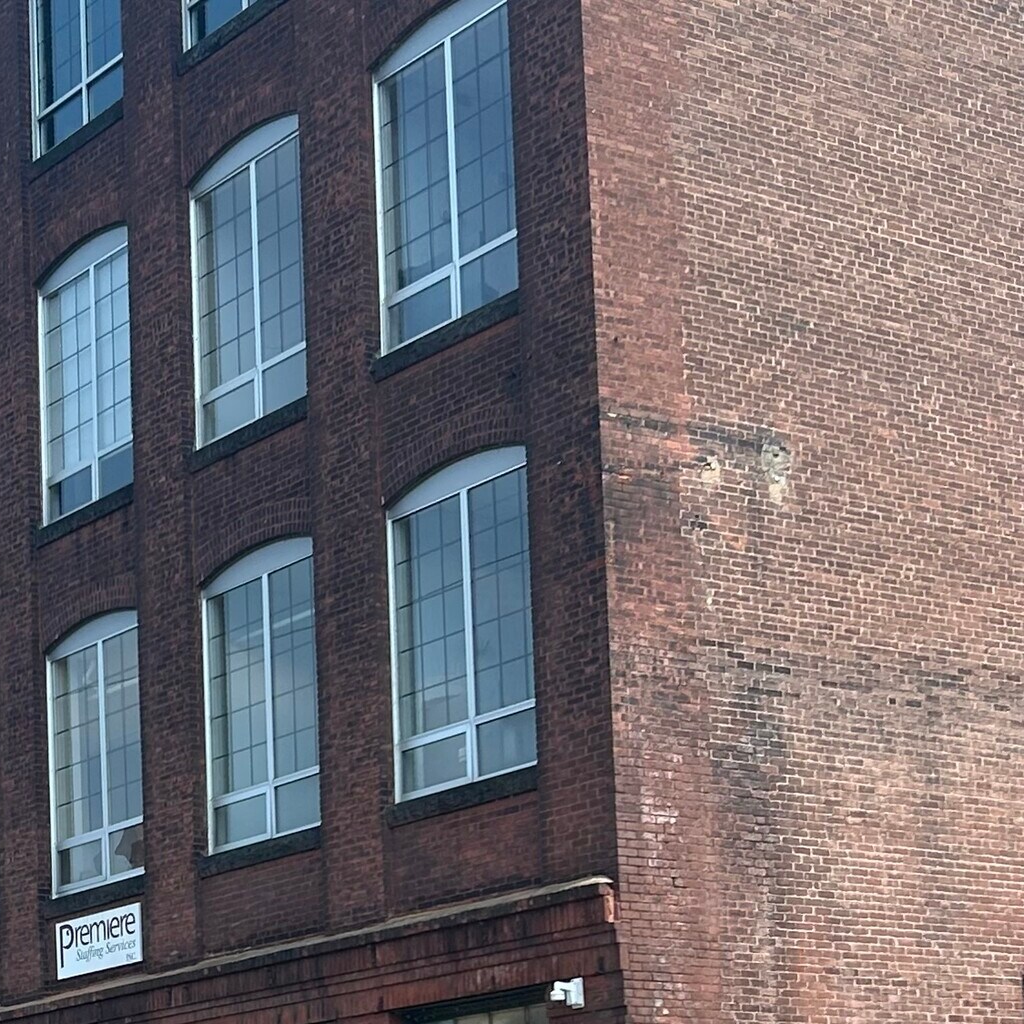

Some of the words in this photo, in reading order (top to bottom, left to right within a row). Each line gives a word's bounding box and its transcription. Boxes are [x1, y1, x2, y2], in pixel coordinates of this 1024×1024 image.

[59, 912, 136, 969] Premiere
[76, 945, 104, 963] Staffing
[105, 939, 136, 955] Services
